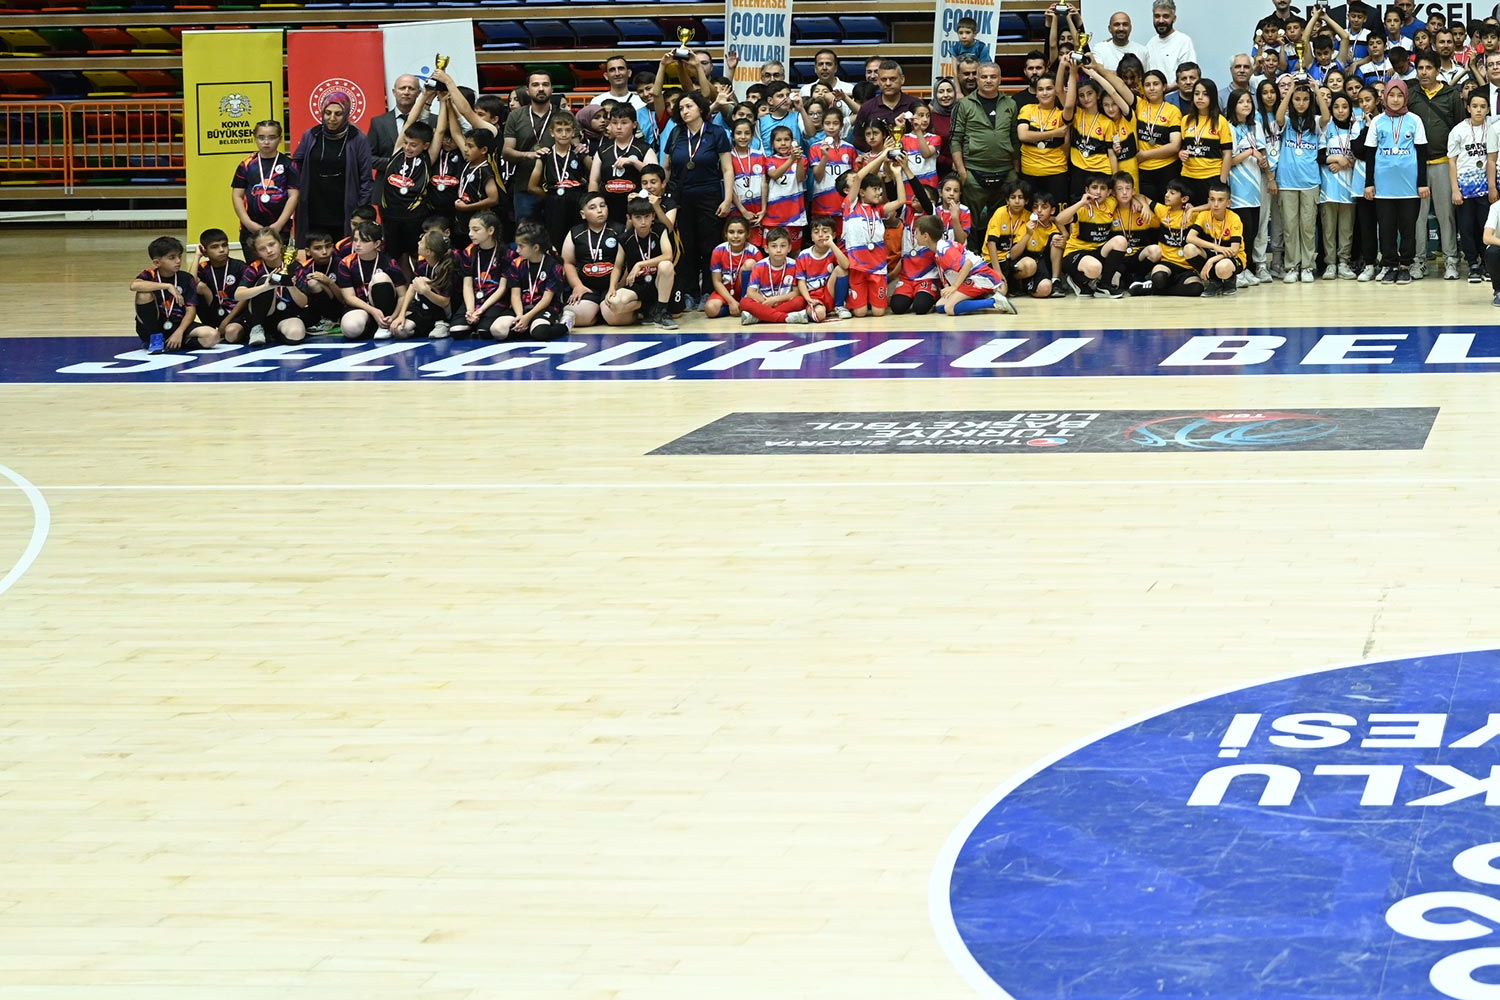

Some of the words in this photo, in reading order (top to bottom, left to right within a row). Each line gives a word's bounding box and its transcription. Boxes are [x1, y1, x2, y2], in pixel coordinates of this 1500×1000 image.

[730, 11, 785, 41] ÇOCUK
[221, 120, 250, 128] KONYA
[207, 128, 255, 139] BÜYÜKŞEH
[915, 155, 922, 164] 6
[830, 165, 841, 176] 10
[780, 175, 788, 185] 2
[55, 338, 1095, 378] SELÇUKLU
[806, 420, 1092, 431] BASKETBOL
